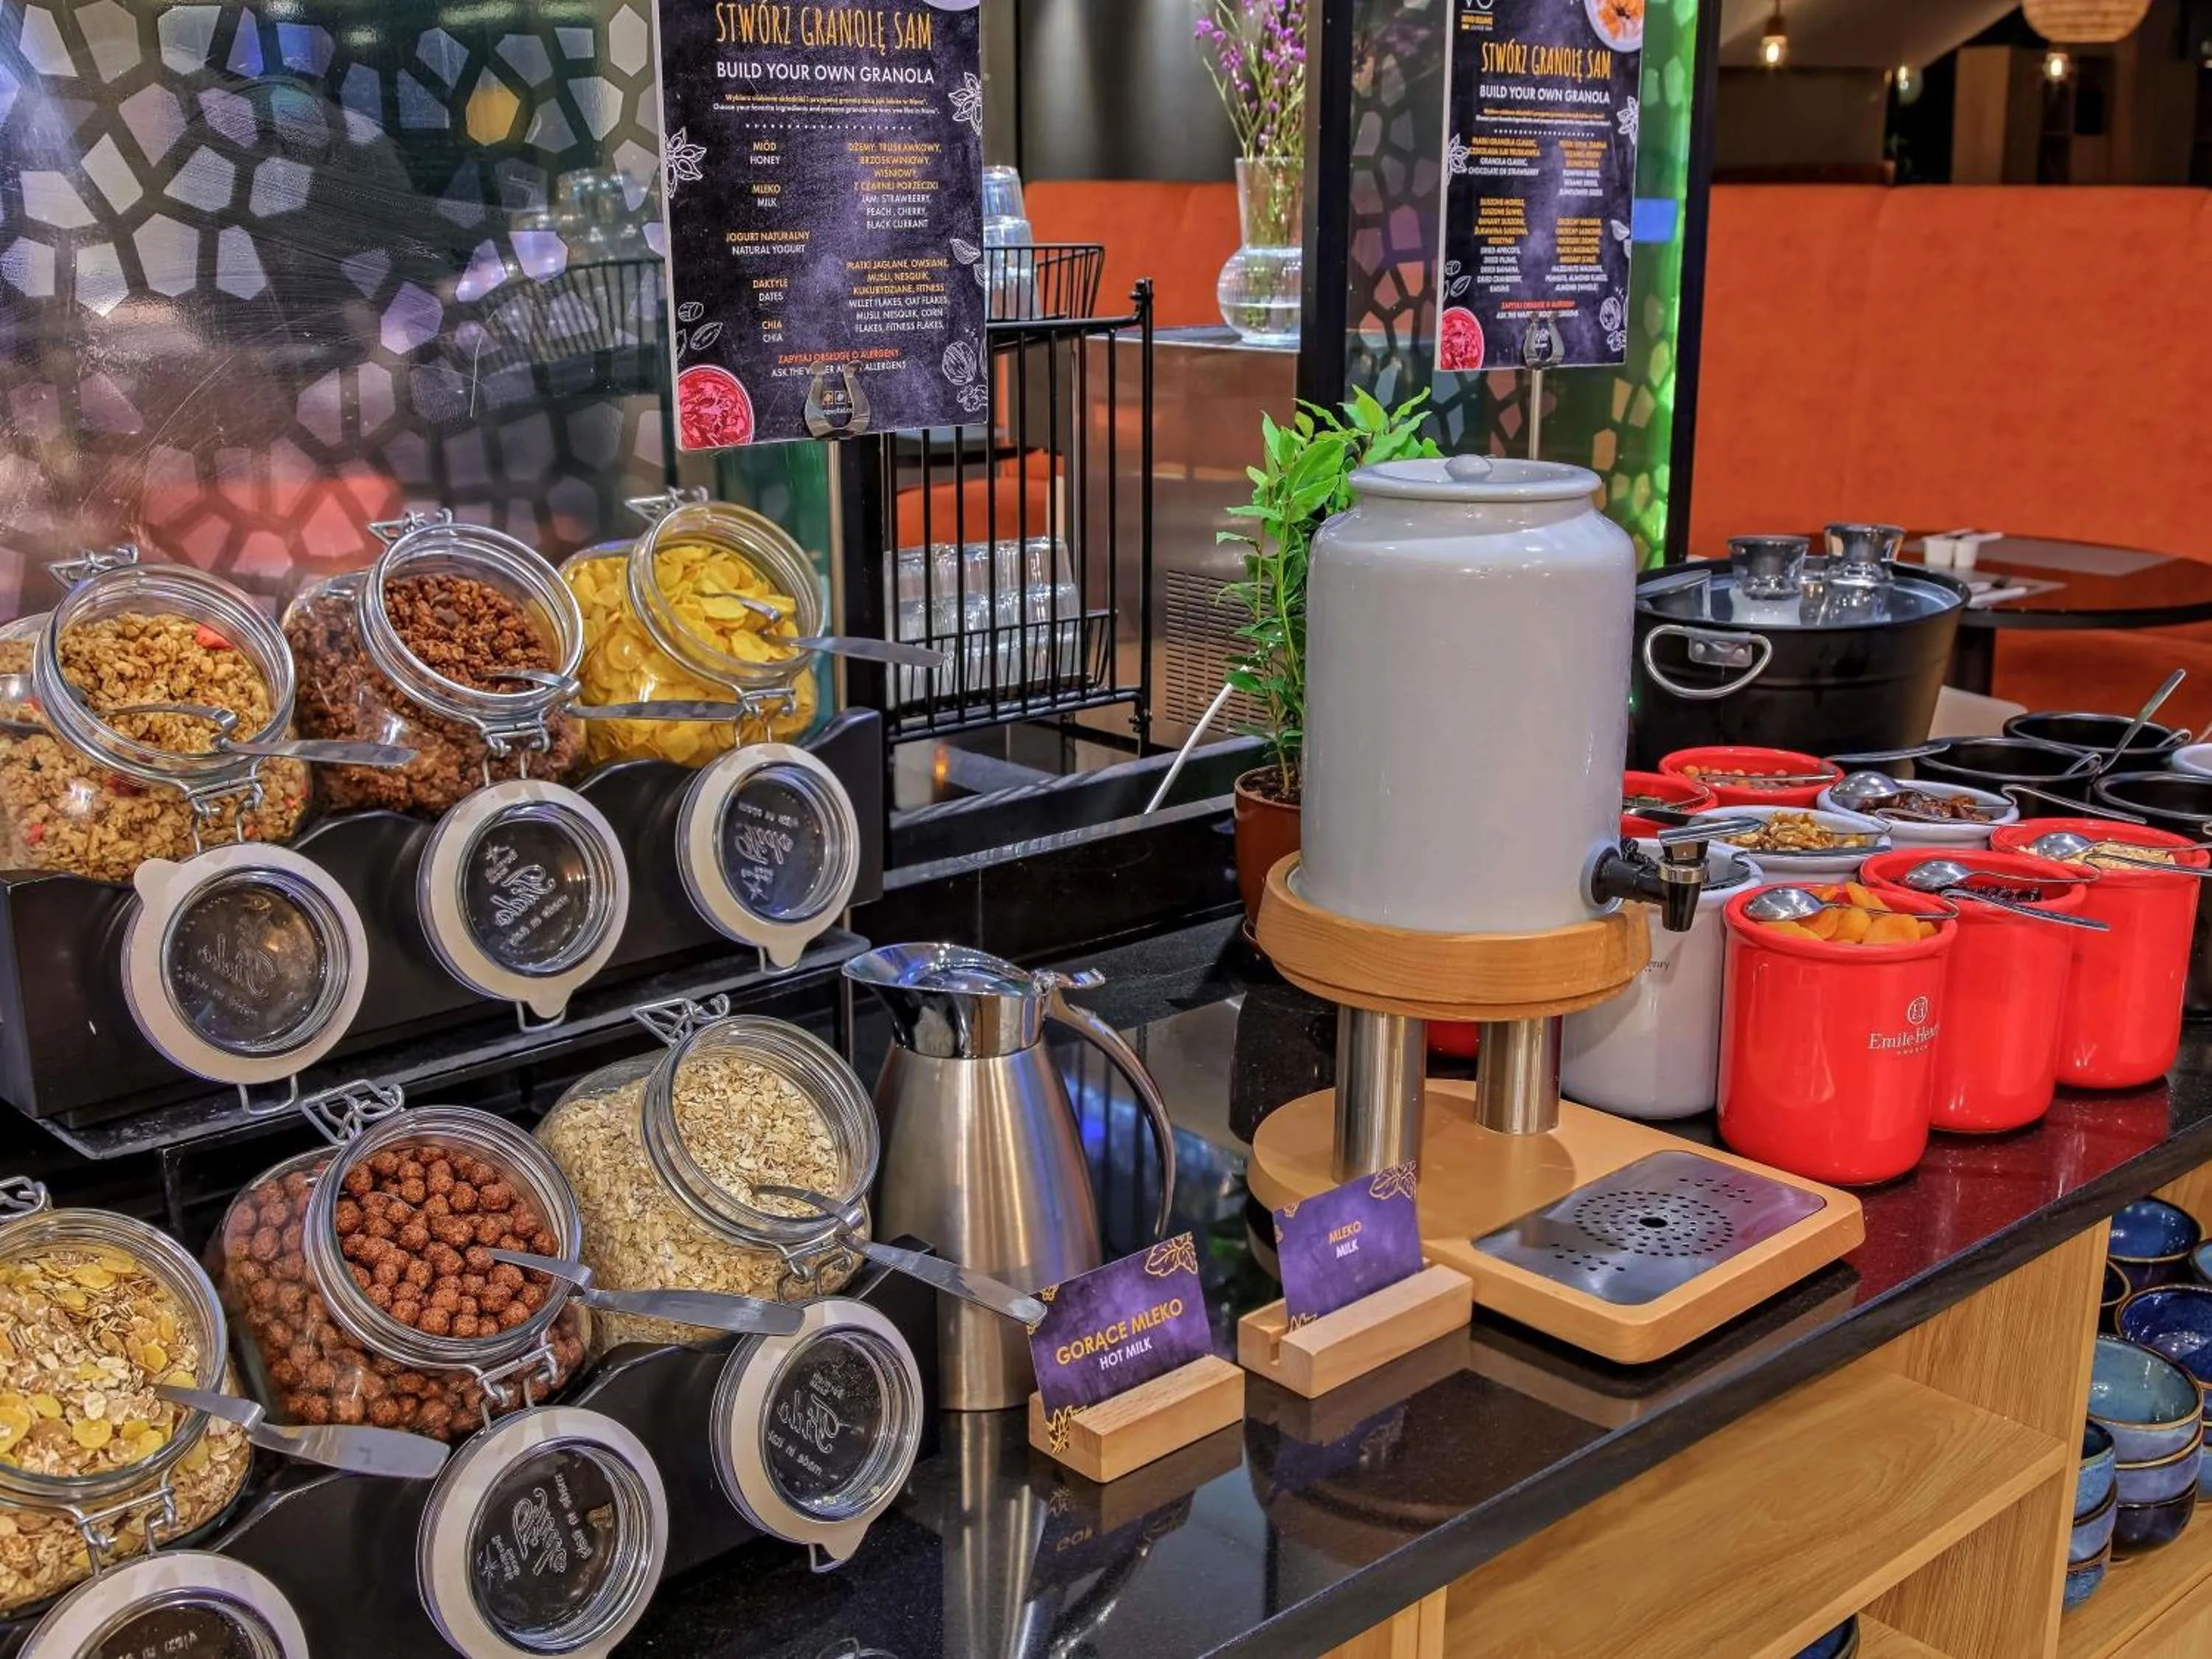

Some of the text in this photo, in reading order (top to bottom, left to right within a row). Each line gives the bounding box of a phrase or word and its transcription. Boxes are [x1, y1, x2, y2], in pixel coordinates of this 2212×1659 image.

[716, 0, 932, 55] STWÓRZ GRANOLĘ SAM
[1481, 38, 1611, 83] STWÓRZ GRANOLĘ SAM
[717, 61, 934, 84] BUILD YOUR OWN GRANOLA
[1480, 85, 1610, 104] BUILD YOUR OWN GRANOLA
[753, 141, 776, 151] MIÓD
[750, 156, 782, 165] HONEY
[751, 184, 781, 194] MLEKO
[757, 198, 778, 207] MILK
[866, 220, 928, 229] BLACK CURRANT
[726, 231, 810, 242] JOGURT NATURALNY
[732, 244, 805, 255] NATURAL YOGURT
[753, 279, 788, 288] DAKTYLE
[916, 283, 945, 293] FITNESS
[759, 291, 784, 302] DATES
[921, 308, 943, 318] CORN
[762, 320, 782, 330] CHIA
[886, 321, 915, 332] FITNESS
[762, 333, 783, 343] CHIA
[852, 350, 858, 359] O
[771, 368, 787, 378] ASK
[789, 367, 804, 376] THE
[865, 361, 907, 371] ALLERGENS
[1868, 1032, 1915, 1050] Emile
[1329, 1221, 1362, 1245] MLEKO
[1336, 1239, 1359, 1258] MILK
[1056, 1298, 1183, 1366] GORĄCE MLEKO
[1099, 1337, 1152, 1371] HOT MILK
